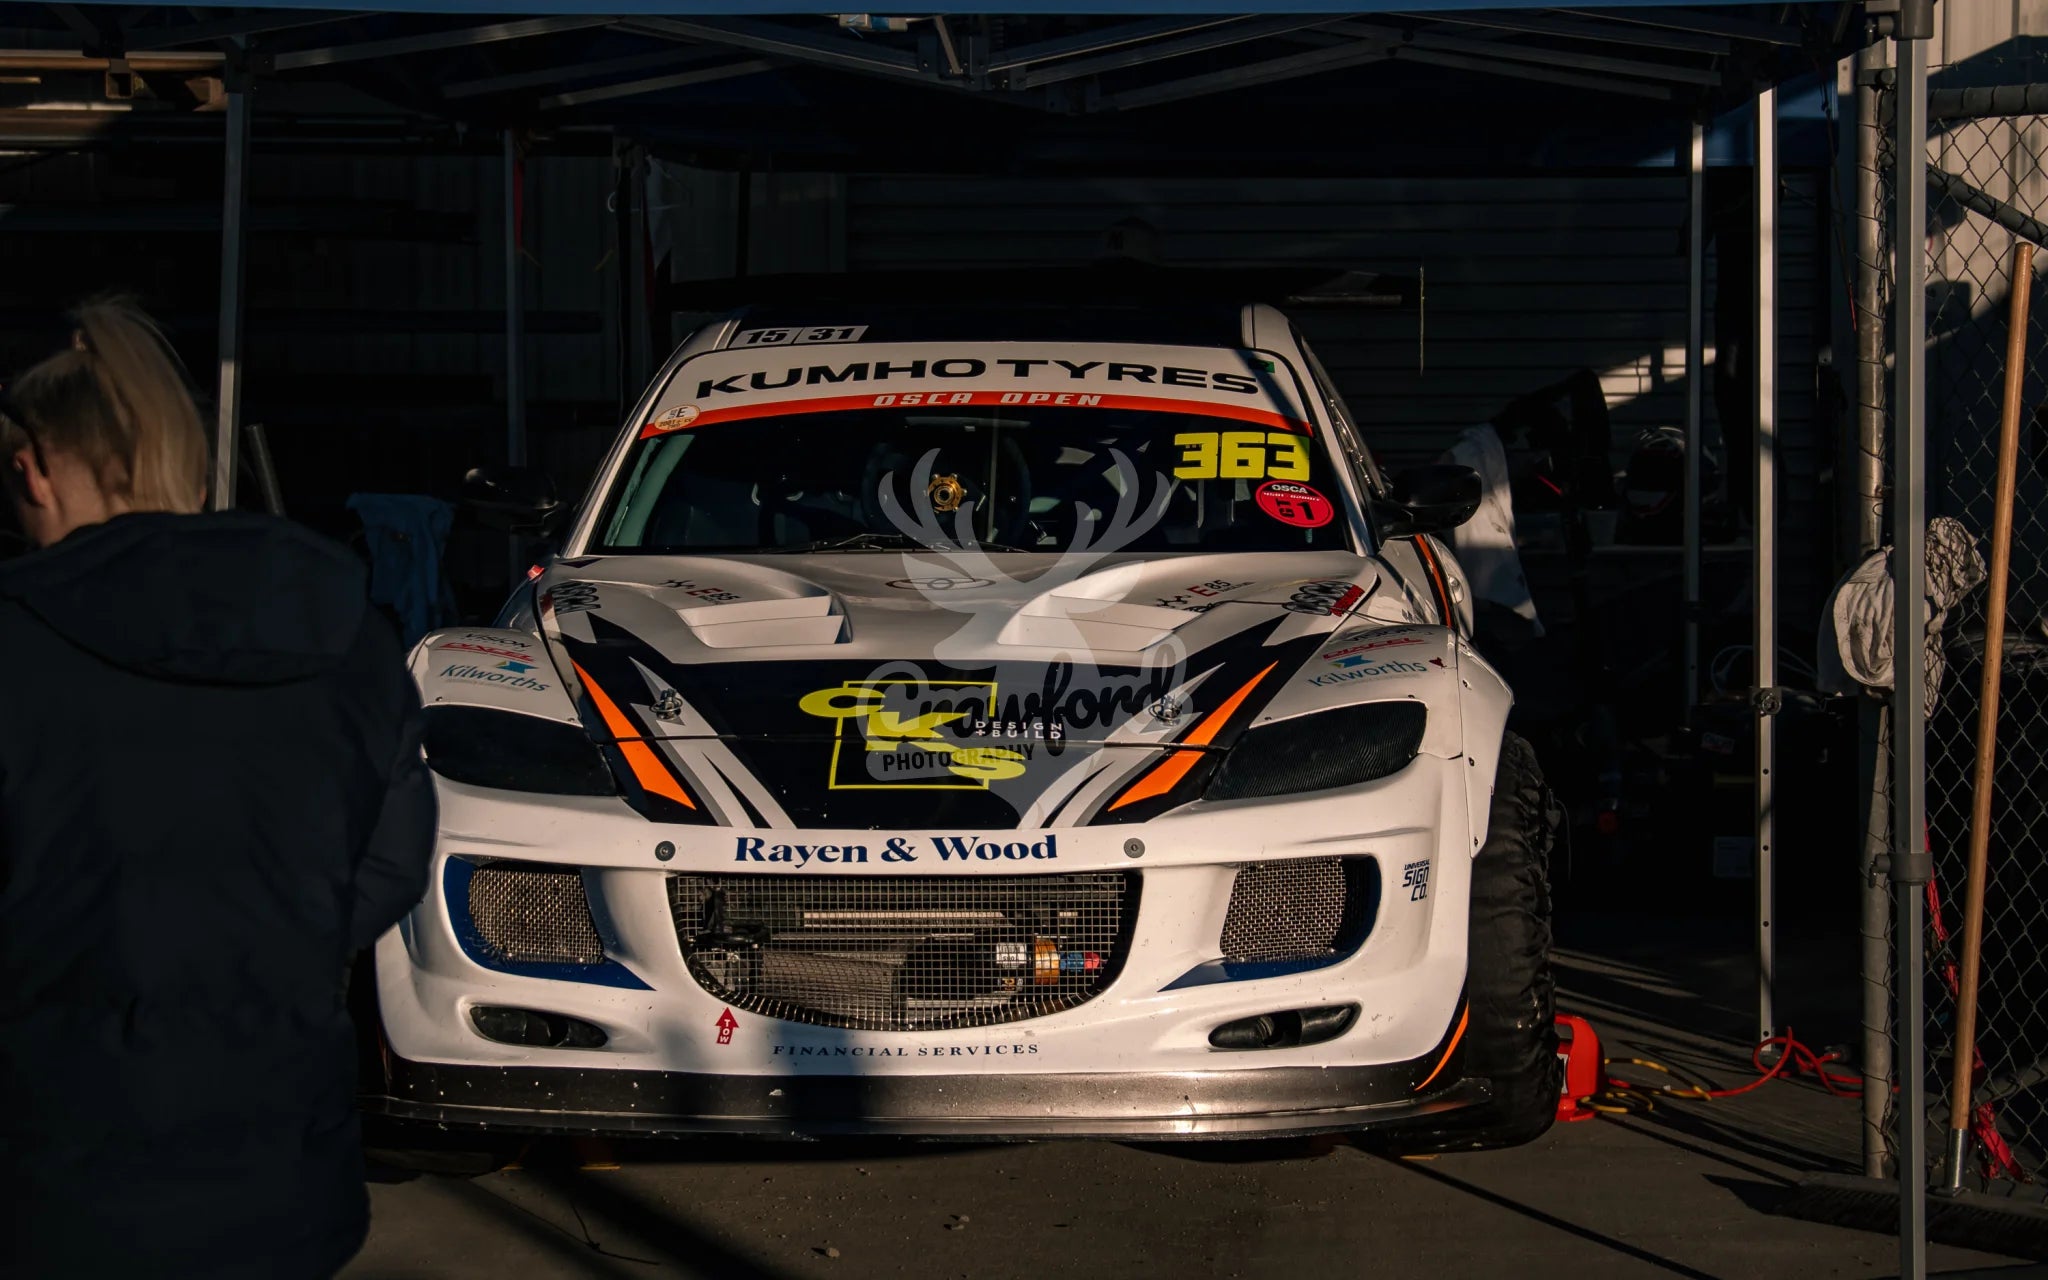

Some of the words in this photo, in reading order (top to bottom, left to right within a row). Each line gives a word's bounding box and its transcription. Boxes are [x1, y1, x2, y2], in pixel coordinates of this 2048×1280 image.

[747, 329, 790, 344] 15
[808, 327, 856, 341] 31
[696, 358, 985, 399] KUMHO
[997, 359, 1259, 395] TYRES
[873, 392, 973, 407] OSCA
[1000, 392, 1102, 407] OPEN
[1174, 431, 1310, 482] 363
[1271, 484, 1308, 494] OSCA
[440, 664, 551, 692] Kilworths
[1308, 661, 1428, 687] Kilworths
[975, 720, 1063, 731] DESIGN
[734, 836, 868, 869] Rayen
[880, 837, 918, 863] &
[930, 834, 1058, 861] Wood
[1402, 866, 1429, 888] SIGN
[720, 1019, 731, 1043] TOW
[772, 1045, 909, 1057] FINANCIAL
[917, 1044, 1039, 1056] SERVICES
